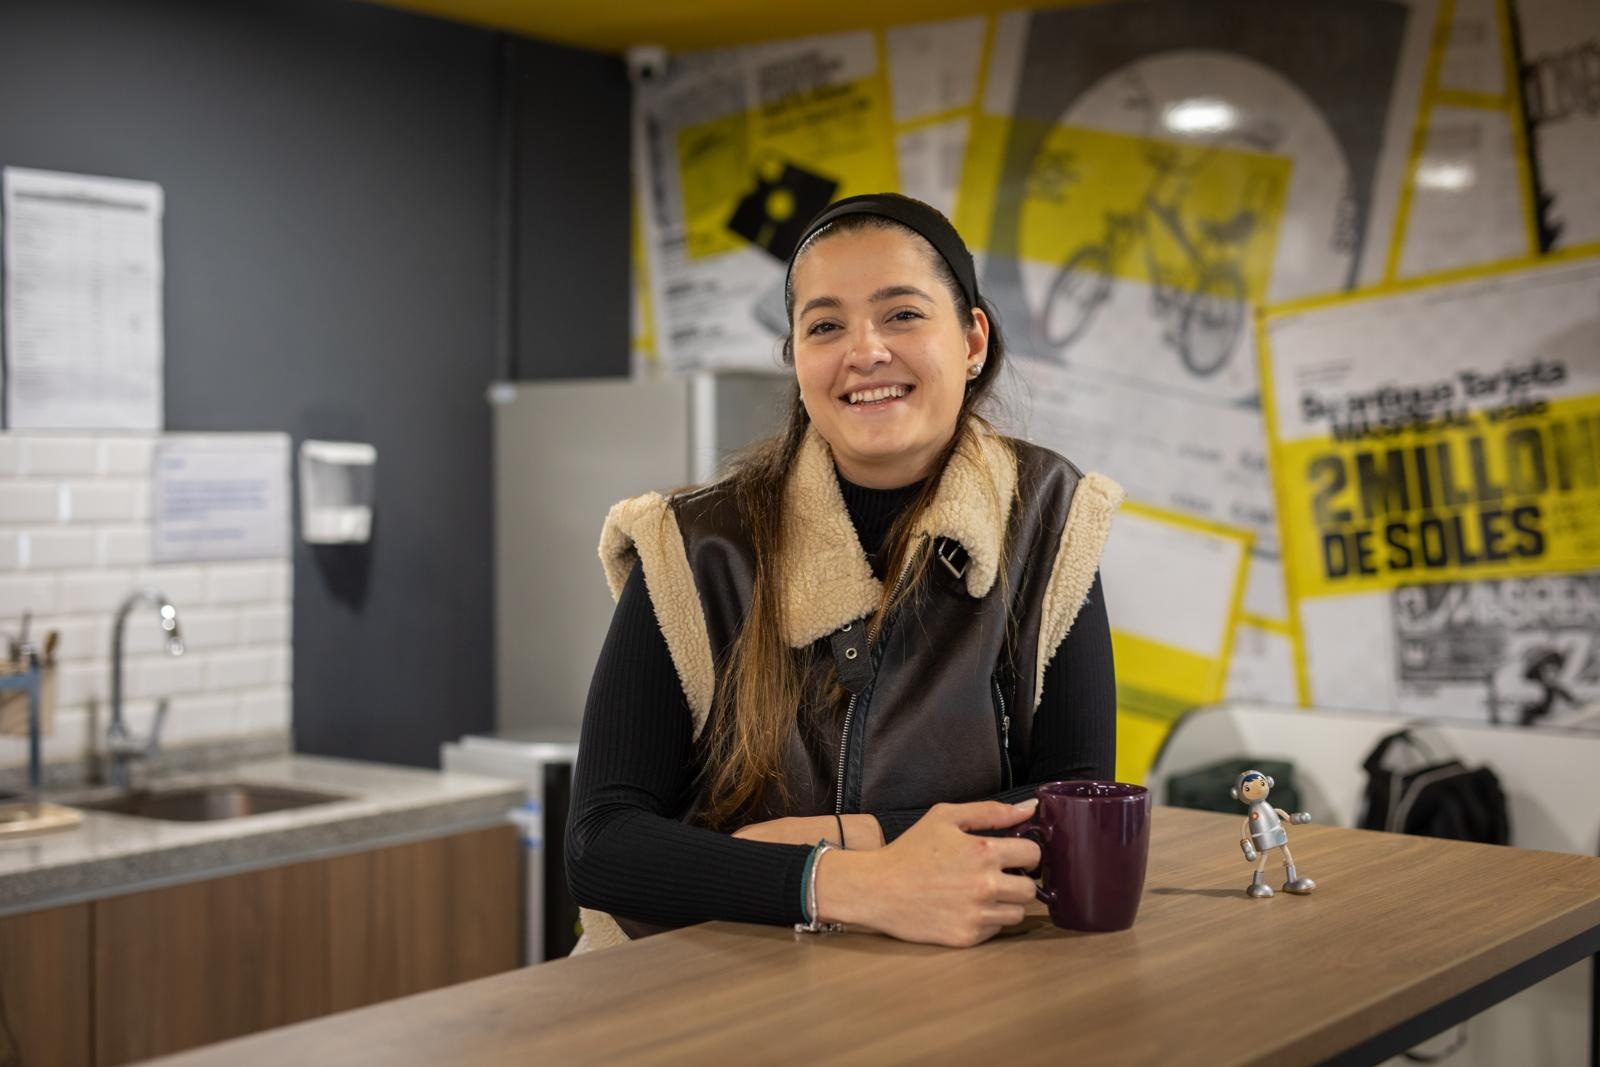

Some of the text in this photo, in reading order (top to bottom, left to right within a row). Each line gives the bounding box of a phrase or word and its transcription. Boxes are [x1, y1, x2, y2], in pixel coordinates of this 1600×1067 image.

[1348, 381, 1454, 416] antigua
[1458, 359, 1568, 395] Tarjeta
[1486, 399, 1550, 422] vale
[1323, 530, 1377, 579] DE
[1386, 505, 1546, 570] SOLES
